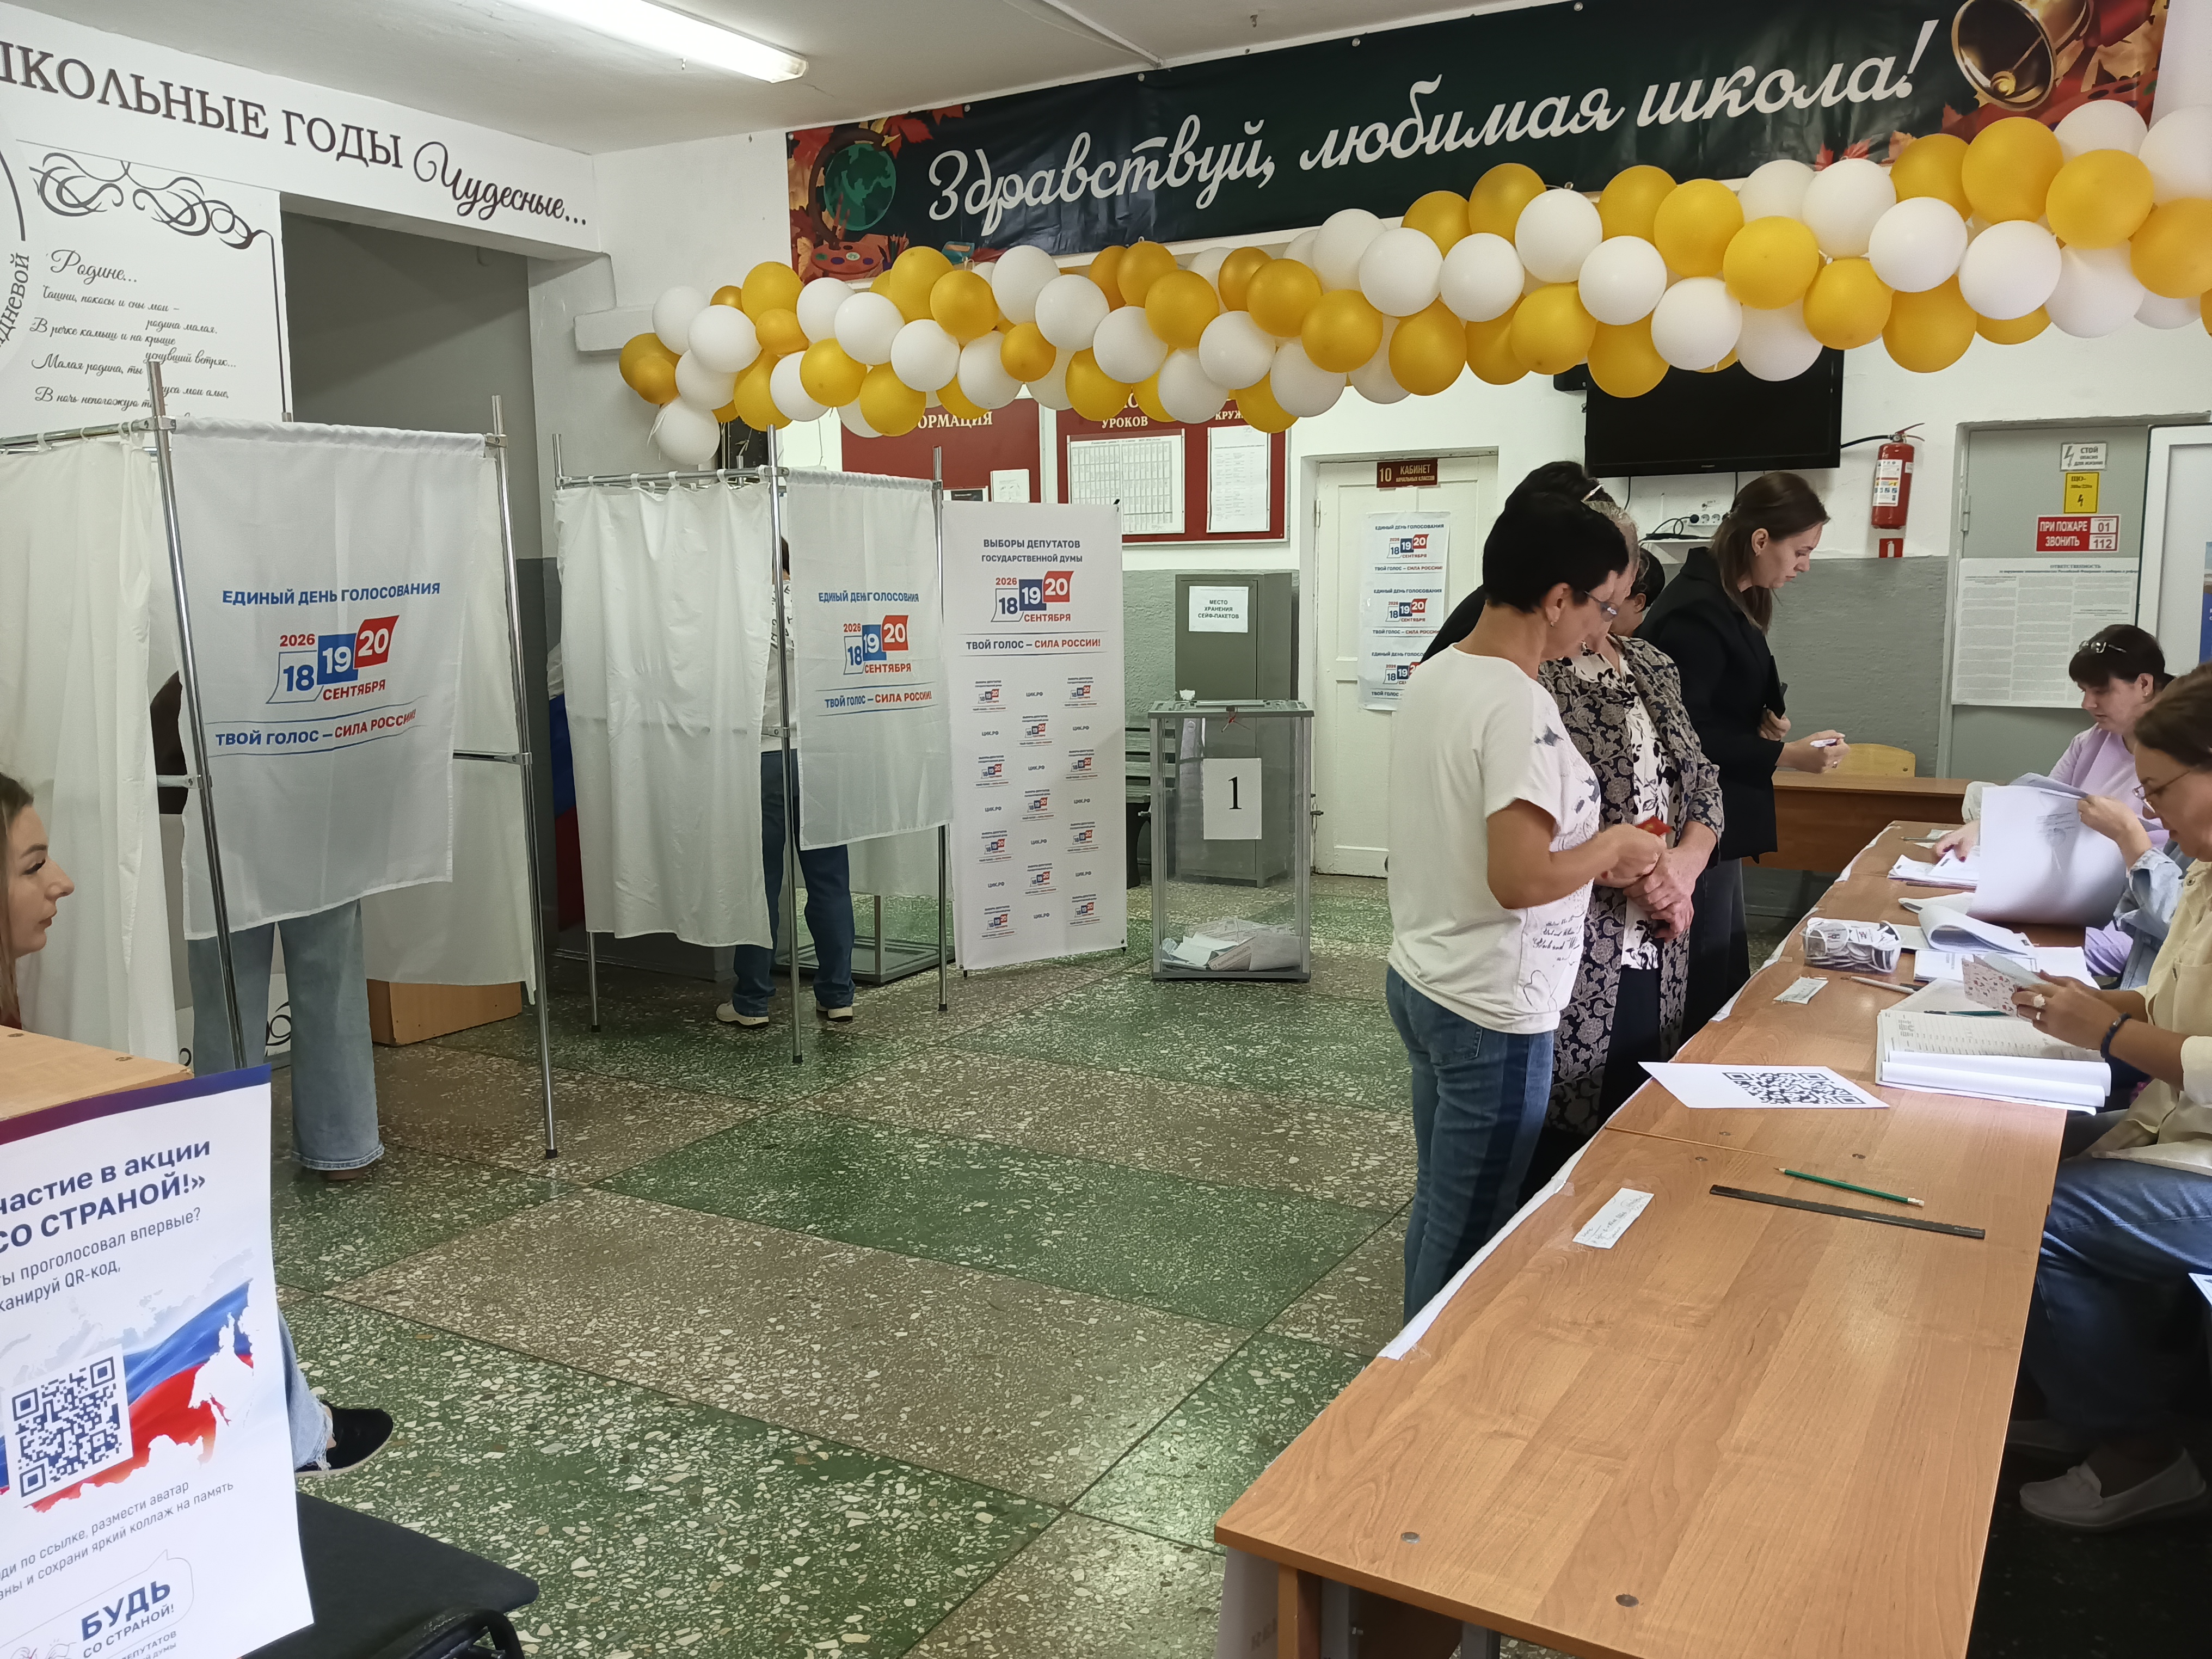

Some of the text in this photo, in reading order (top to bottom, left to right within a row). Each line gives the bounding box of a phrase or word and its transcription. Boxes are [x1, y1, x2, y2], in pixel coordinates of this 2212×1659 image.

[928, 20, 1939, 236] Здравствуй, любимая школа!
[282, 110, 403, 168] ГОДЫ
[0, 252, 29, 347] дневой
[29, 317, 48, 333] В
[80, 328, 118, 341] камыш
[145, 318, 181, 332] родина
[32, 353, 83, 370] Малая
[35, 386, 53, 402] В
[57, 393, 78, 403] ночь
[918, 411, 993, 428] ОРМАЦИЯ
[1102, 416, 1148, 429] УРОКОВ
[1215, 410, 1243, 420] КРУЖ
[1379, 464, 1430, 482] 10 КАБИНЕТ
[2040, 521, 2087, 532] ПРИ ПОЖАРЕ
[2098, 523, 2110, 532] 01
[984, 539, 1080, 549] ВЫБОРЫ ДЕПУТАТОВ
[1402, 542, 1411, 550] 19
[1413, 537, 1425, 545] 20
[2045, 536, 2080, 546] ЗВОНИТЬ
[2093, 539, 2112, 549] 112
[982, 554, 1058, 563] ГОСУДАРСТВЕННОЙ
[996, 577, 1017, 586] 2026
[222, 582, 440, 606] ЕДИНЫЙ ДЕНЬ ГОЛОСОВАНИЯ
[999, 578, 1067, 615] 18 19 20
[1390, 601, 1424, 618] 18 19 20
[844, 623, 861, 632] 2026
[280, 634, 315, 647] 2026
[847, 623, 906, 665] 18 19 20
[966, 640, 991, 649] ТВОЙ
[993, 641, 1023, 649] ГОЛОС
[1062, 639, 1101, 647] РОССИИ!
[283, 629, 389, 691] 18 19 20
[865, 663, 911, 673] СЕНТЯБРЯ
[1398, 669, 1408, 677] 19
[323, 679, 386, 701] СЕНТЯБРЯ
[825, 691, 932, 708] ТВОЙ ГОЛОС СИЛА РОССИИ!
[216, 730, 261, 746] ТВОЙ
[266, 730, 318, 745] ГОЛОС
[335, 722, 368, 739] СИЛА
[1228, 776, 1242, 809] 1
[101, 1165, 116, 1183] в
[125, 1141, 210, 1177] акции
[41, 1171, 205, 1237] СТРАНОЙ!»
[20, 1235, 125, 1280] проголосовал
[131, 1207, 201, 1242] впервые?
[65, 1259, 120, 1287] QR-код,
[0, 1482, 189, 1581] ди по ссылке, размести аватар
[27, 1575, 33, 1586] и
[38, 1547, 88, 1580] сохрани
[91, 1525, 126, 1553] яркий
[130, 1505, 174, 1534] коллаж
[176, 1499, 191, 1513] на
[193, 1482, 234, 1506] память
[81, 1581, 170, 1641] БУДЬ
[83, 1603, 174, 1658] СО СТРАНОЙ!
[153, 1642, 176, 1658] ДУМЫ
